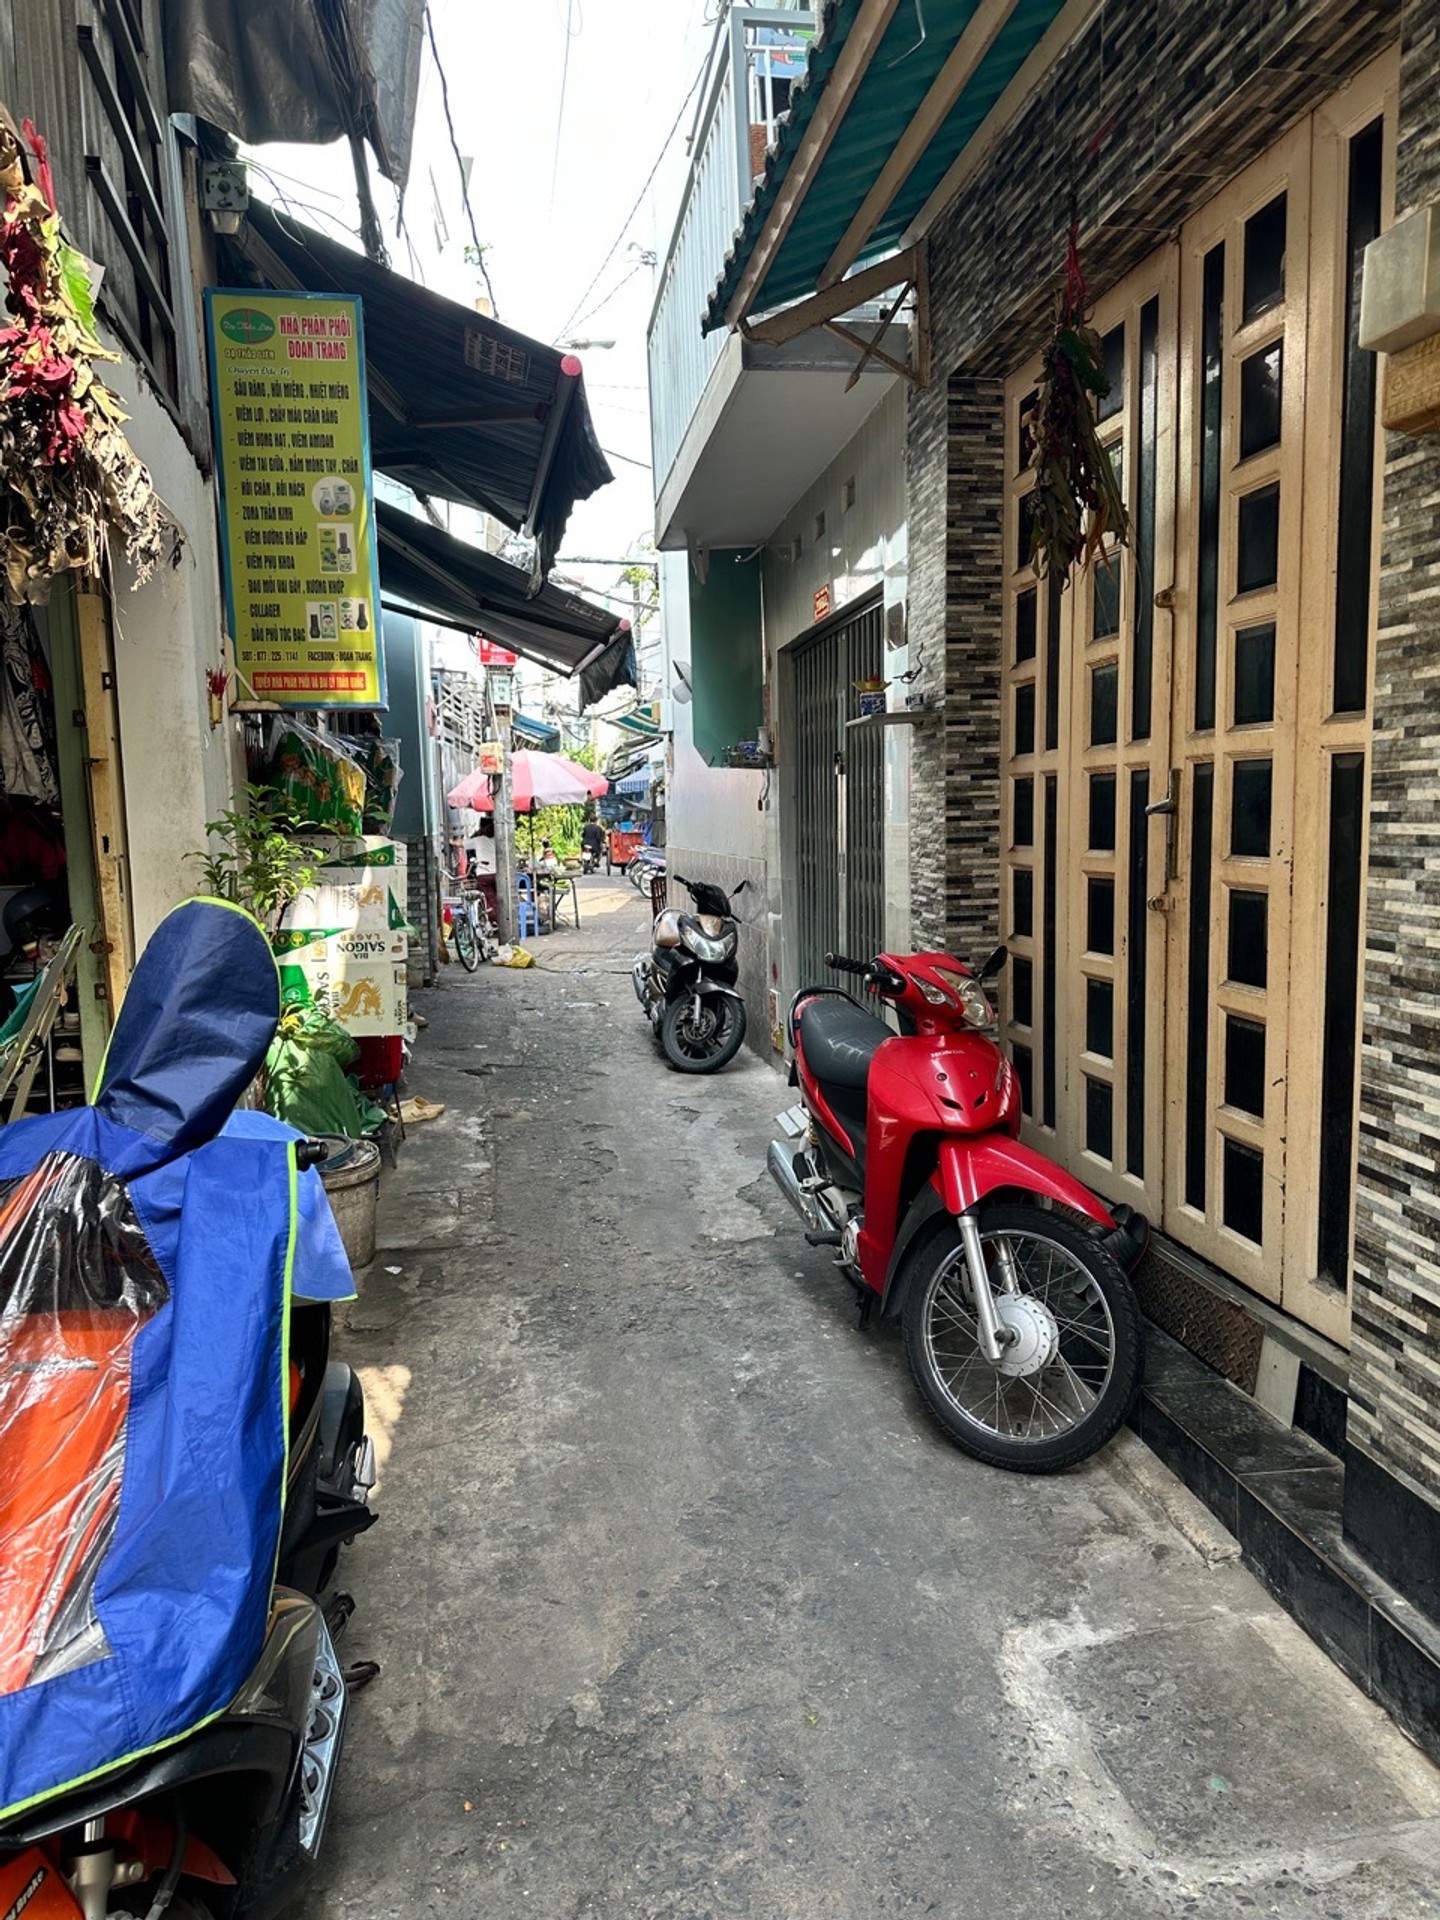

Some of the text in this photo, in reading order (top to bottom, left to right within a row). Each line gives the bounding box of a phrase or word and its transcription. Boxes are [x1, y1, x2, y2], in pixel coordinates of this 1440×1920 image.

[280, 311, 351, 337] NHÀ PHÂN PHỐI
[317, 341, 346, 360] TRANG
[249, 603, 281, 618] COLLAGEN
[341, 933, 380, 942] LAGER
[336, 941, 385, 952] SAIGON
[16, 1869, 44, 1914] Brake
